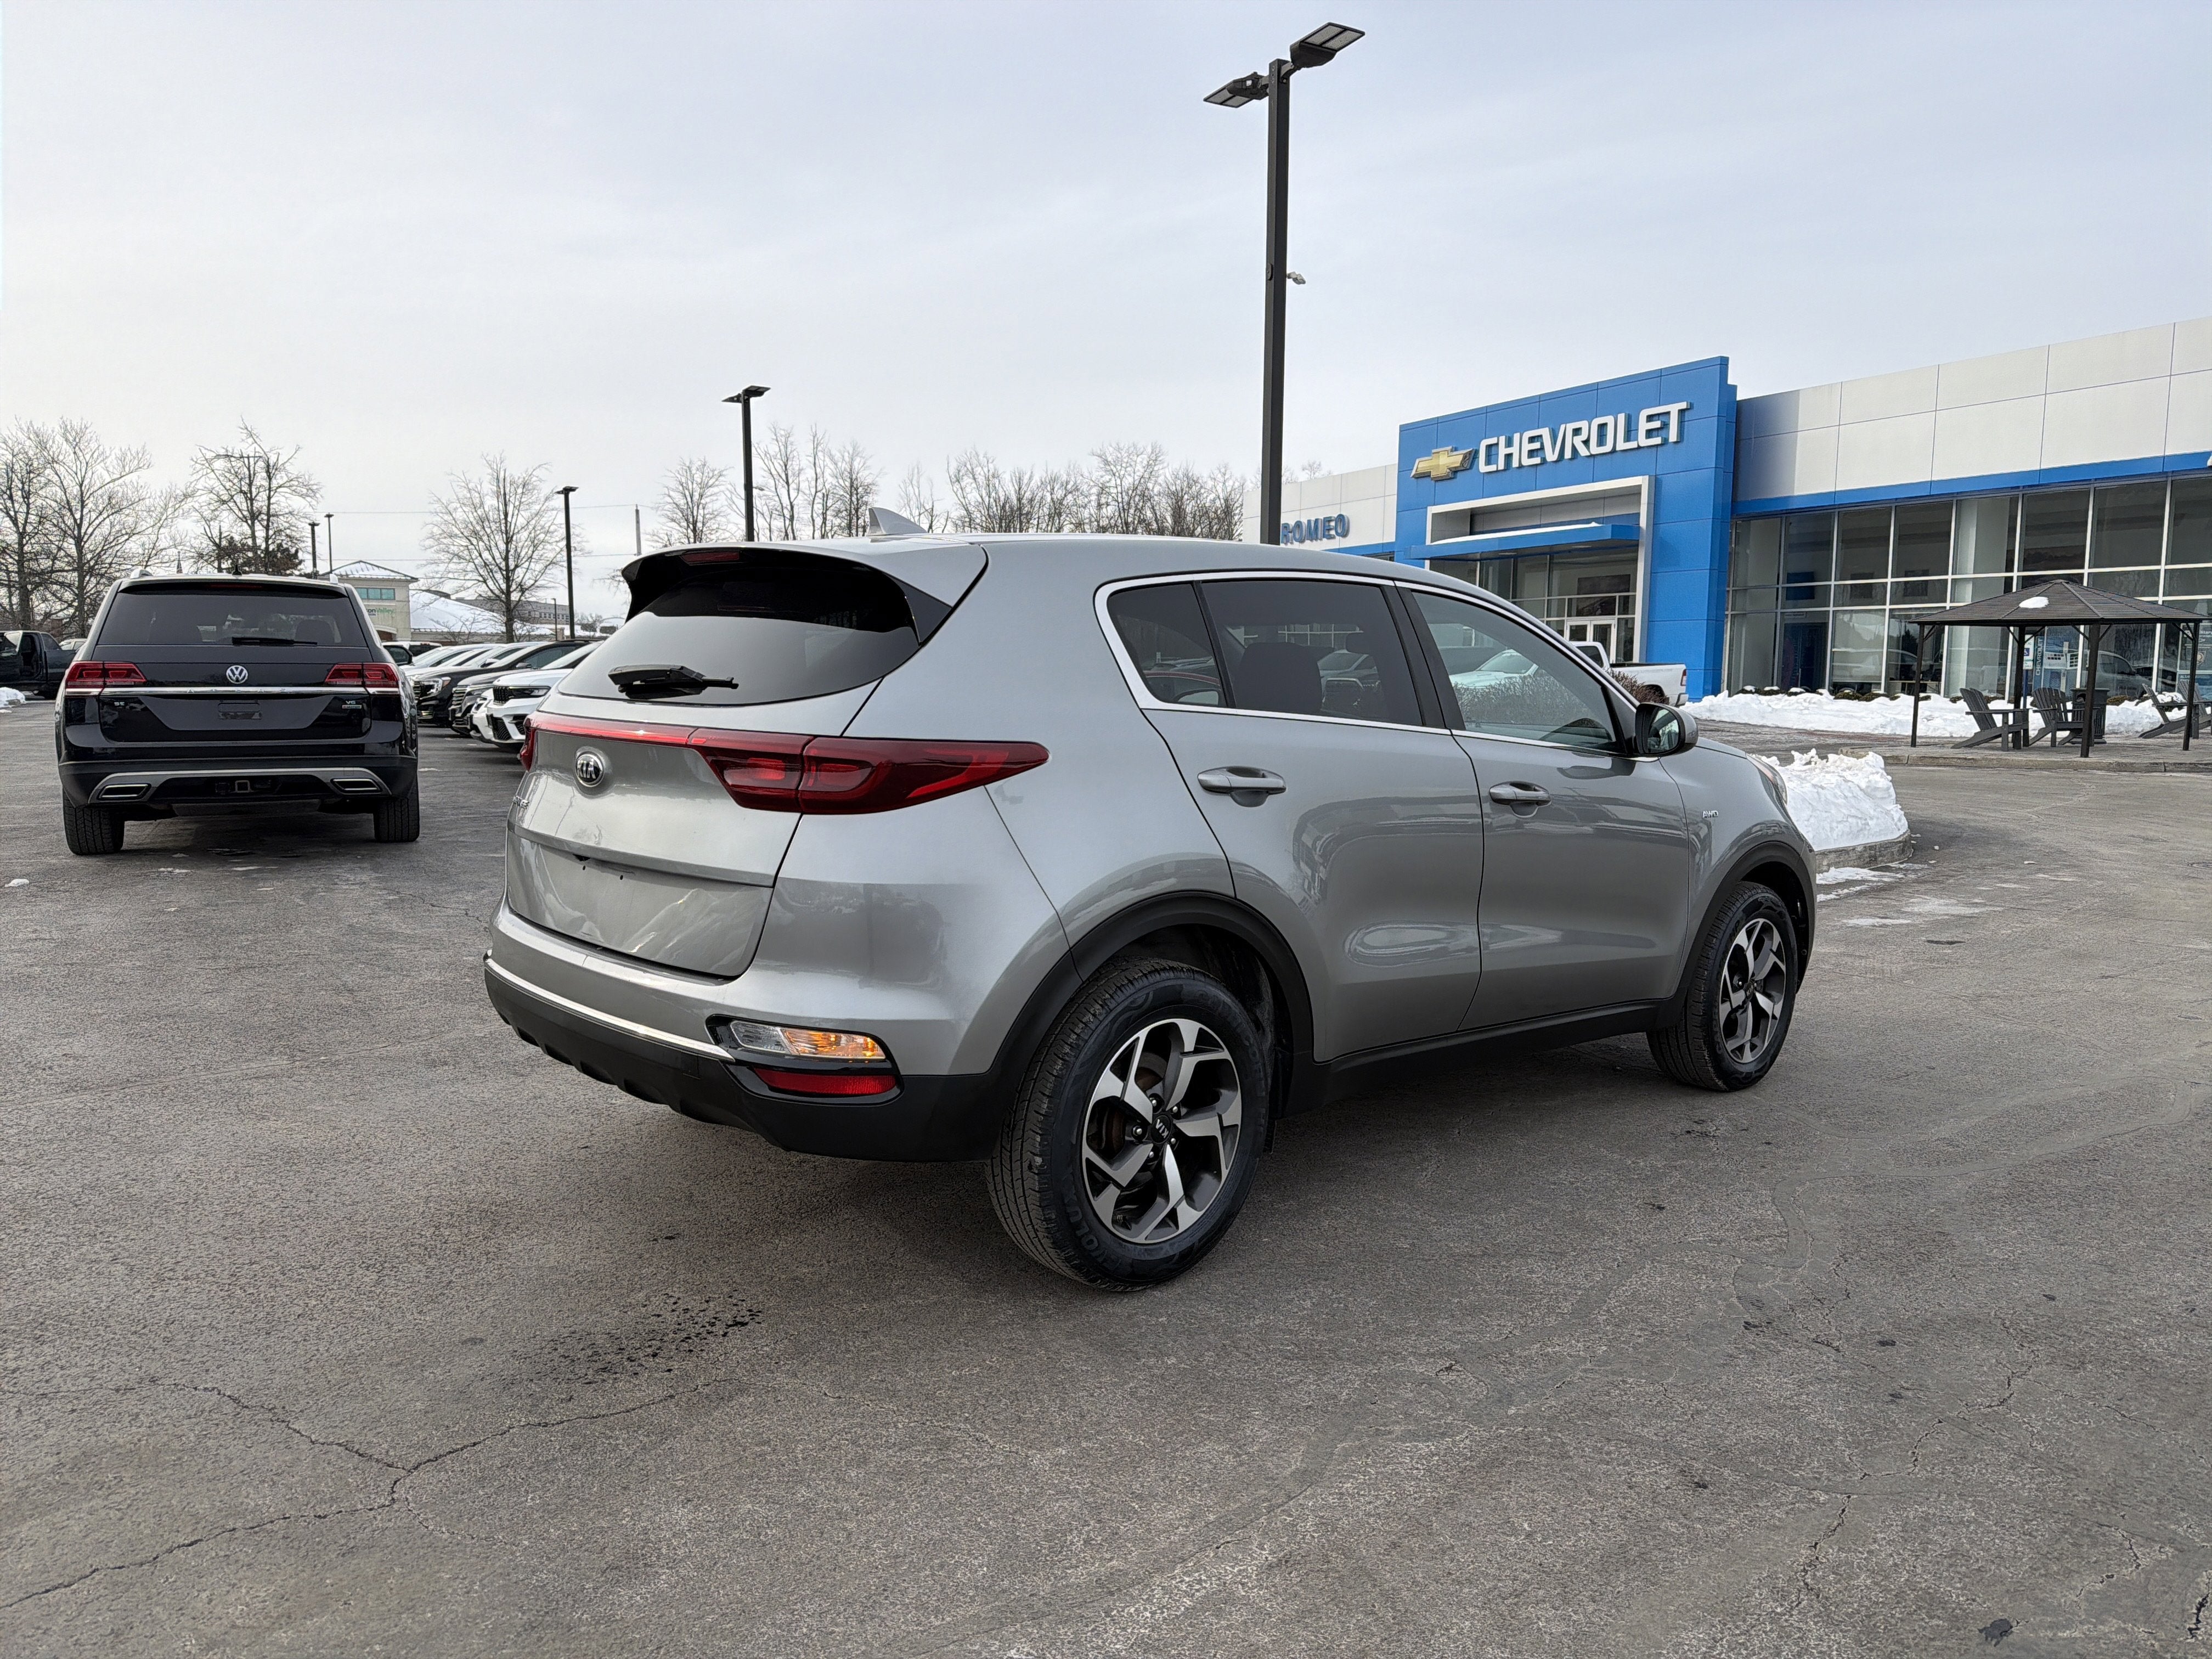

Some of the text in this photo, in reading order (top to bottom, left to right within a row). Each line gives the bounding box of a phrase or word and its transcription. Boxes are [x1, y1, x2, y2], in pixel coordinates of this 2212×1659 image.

[1479, 401, 1691, 473] CHEVROLET
[1280, 514, 1350, 545] ROMEO
[2035, 636, 2044, 675] CHEVROLET
[577, 759, 596, 779] KIA
[1155, 1119, 1169, 1138] KIA
